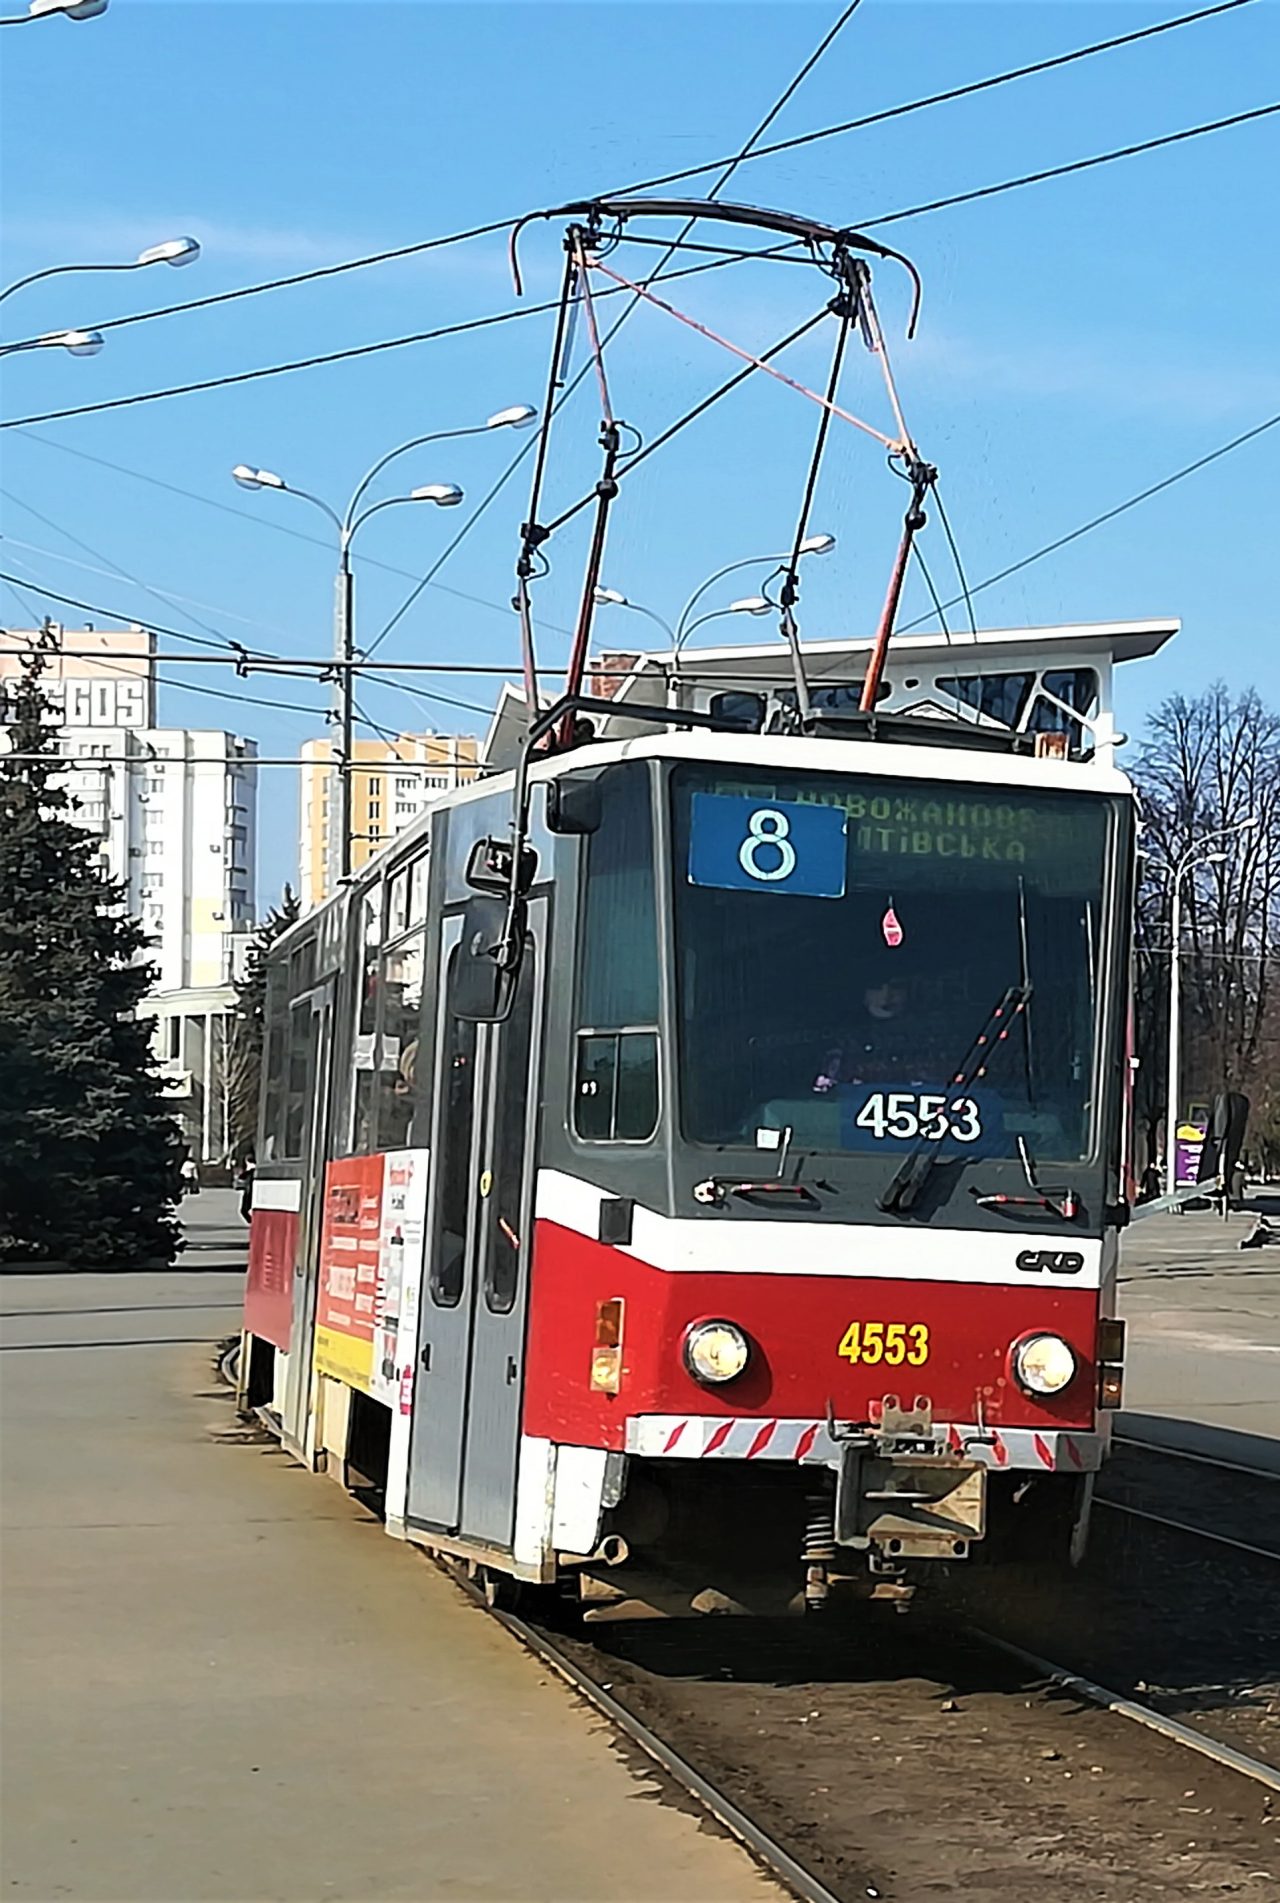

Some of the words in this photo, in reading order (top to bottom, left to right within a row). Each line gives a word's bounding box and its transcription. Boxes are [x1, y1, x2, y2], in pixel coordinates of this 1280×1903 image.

[739, 808, 797, 880] 8
[856, 1093, 981, 1142] 4553
[838, 1321, 929, 1365] 4553
